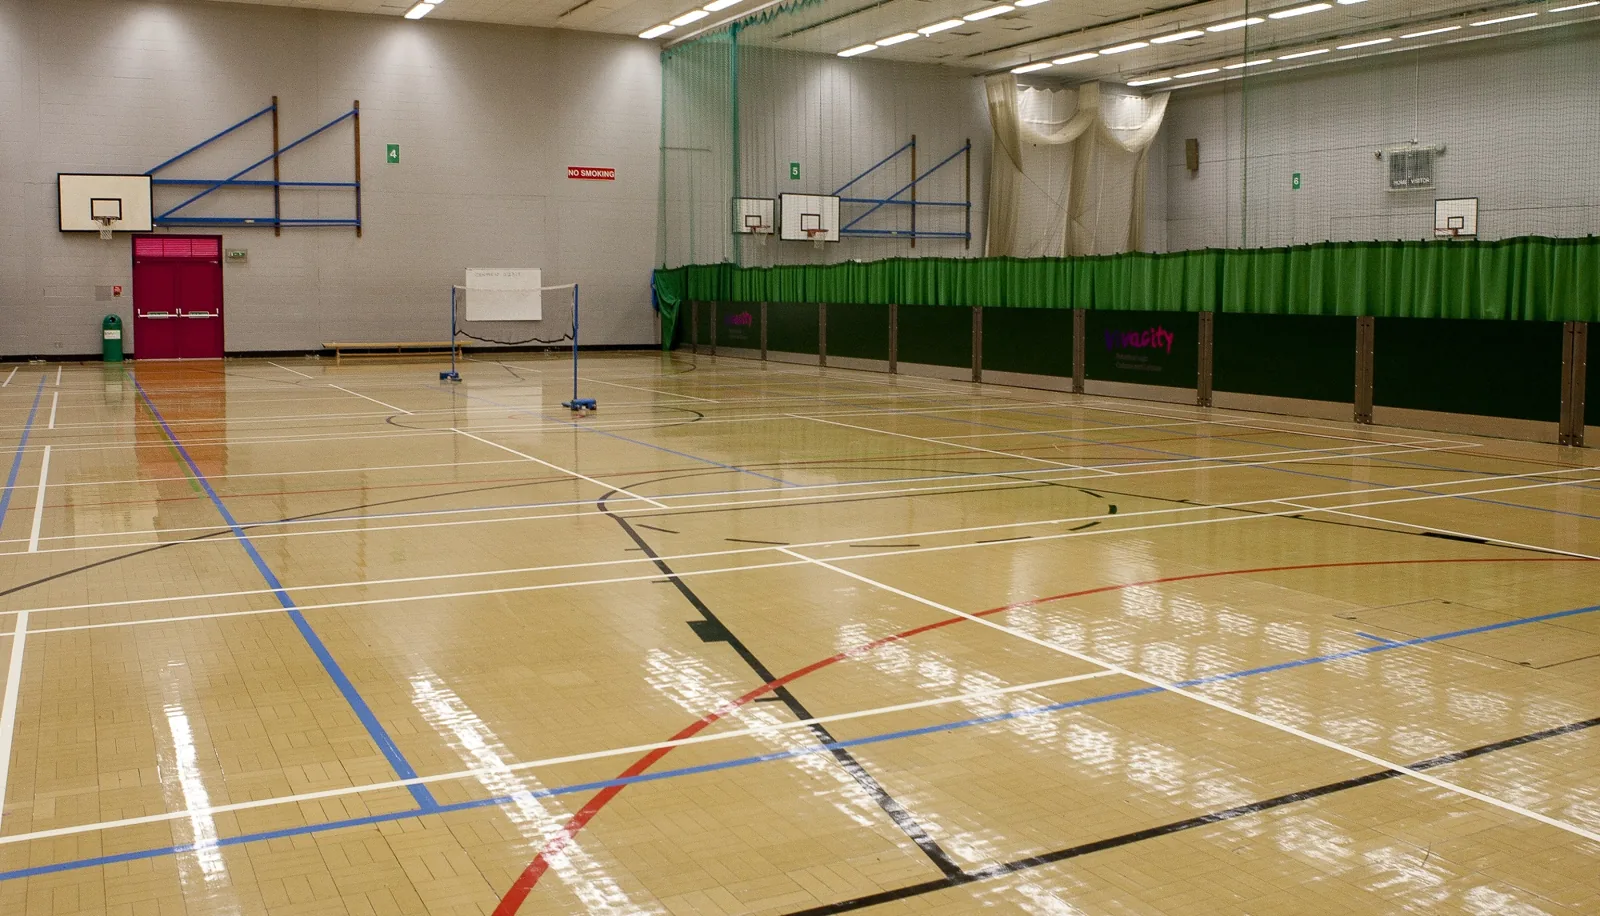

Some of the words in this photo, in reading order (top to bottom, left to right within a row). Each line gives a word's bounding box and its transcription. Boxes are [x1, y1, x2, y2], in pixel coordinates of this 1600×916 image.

[389, 149, 397, 159] 4
[568, 169, 580, 177] NO
[580, 169, 615, 178] SMOKING
[792, 166, 798, 176] 5
[1293, 177, 1299, 185] 6
